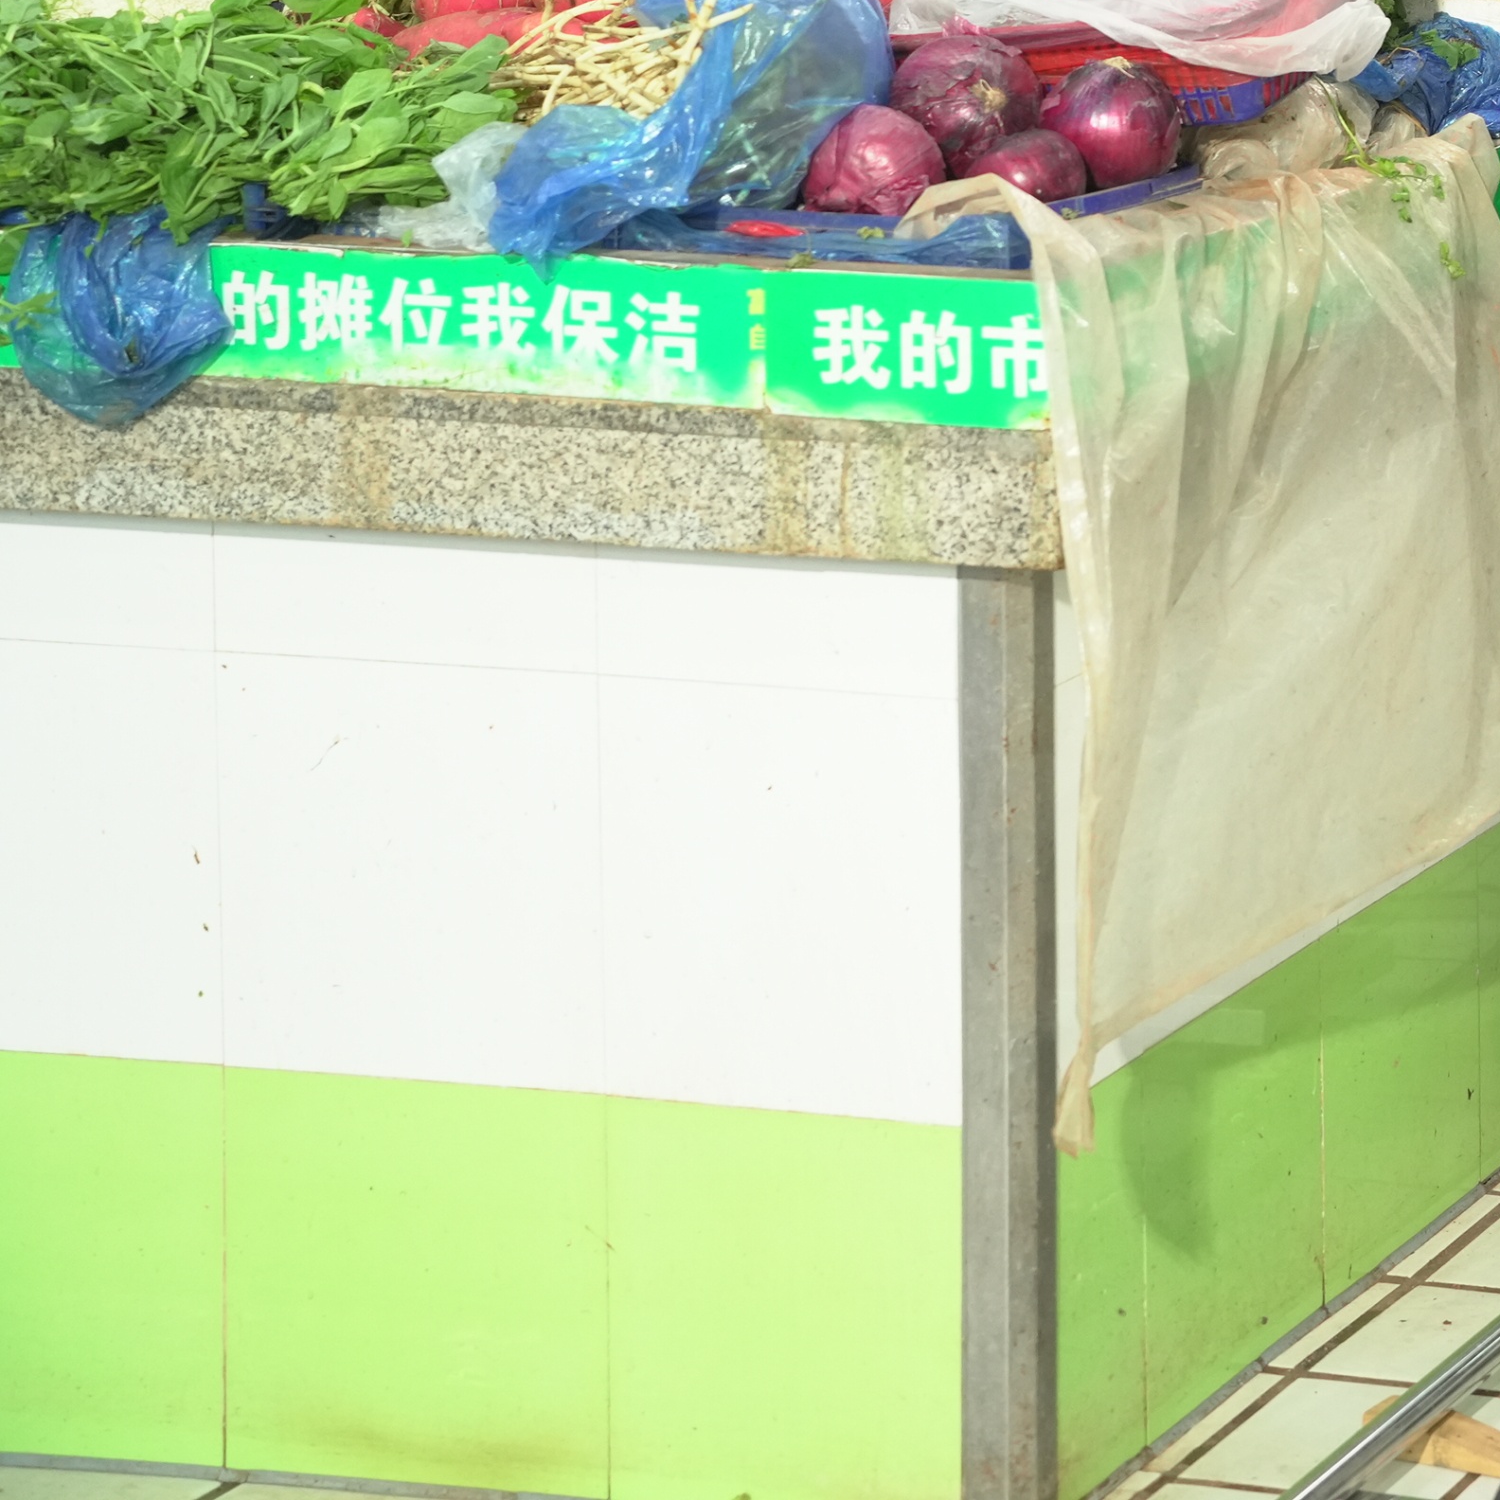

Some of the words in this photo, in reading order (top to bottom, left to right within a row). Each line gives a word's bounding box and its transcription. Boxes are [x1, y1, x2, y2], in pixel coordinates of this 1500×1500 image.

[221, 270, 701, 372] 的摊位我保洁
[812, 304, 1049, 399] 我的市
